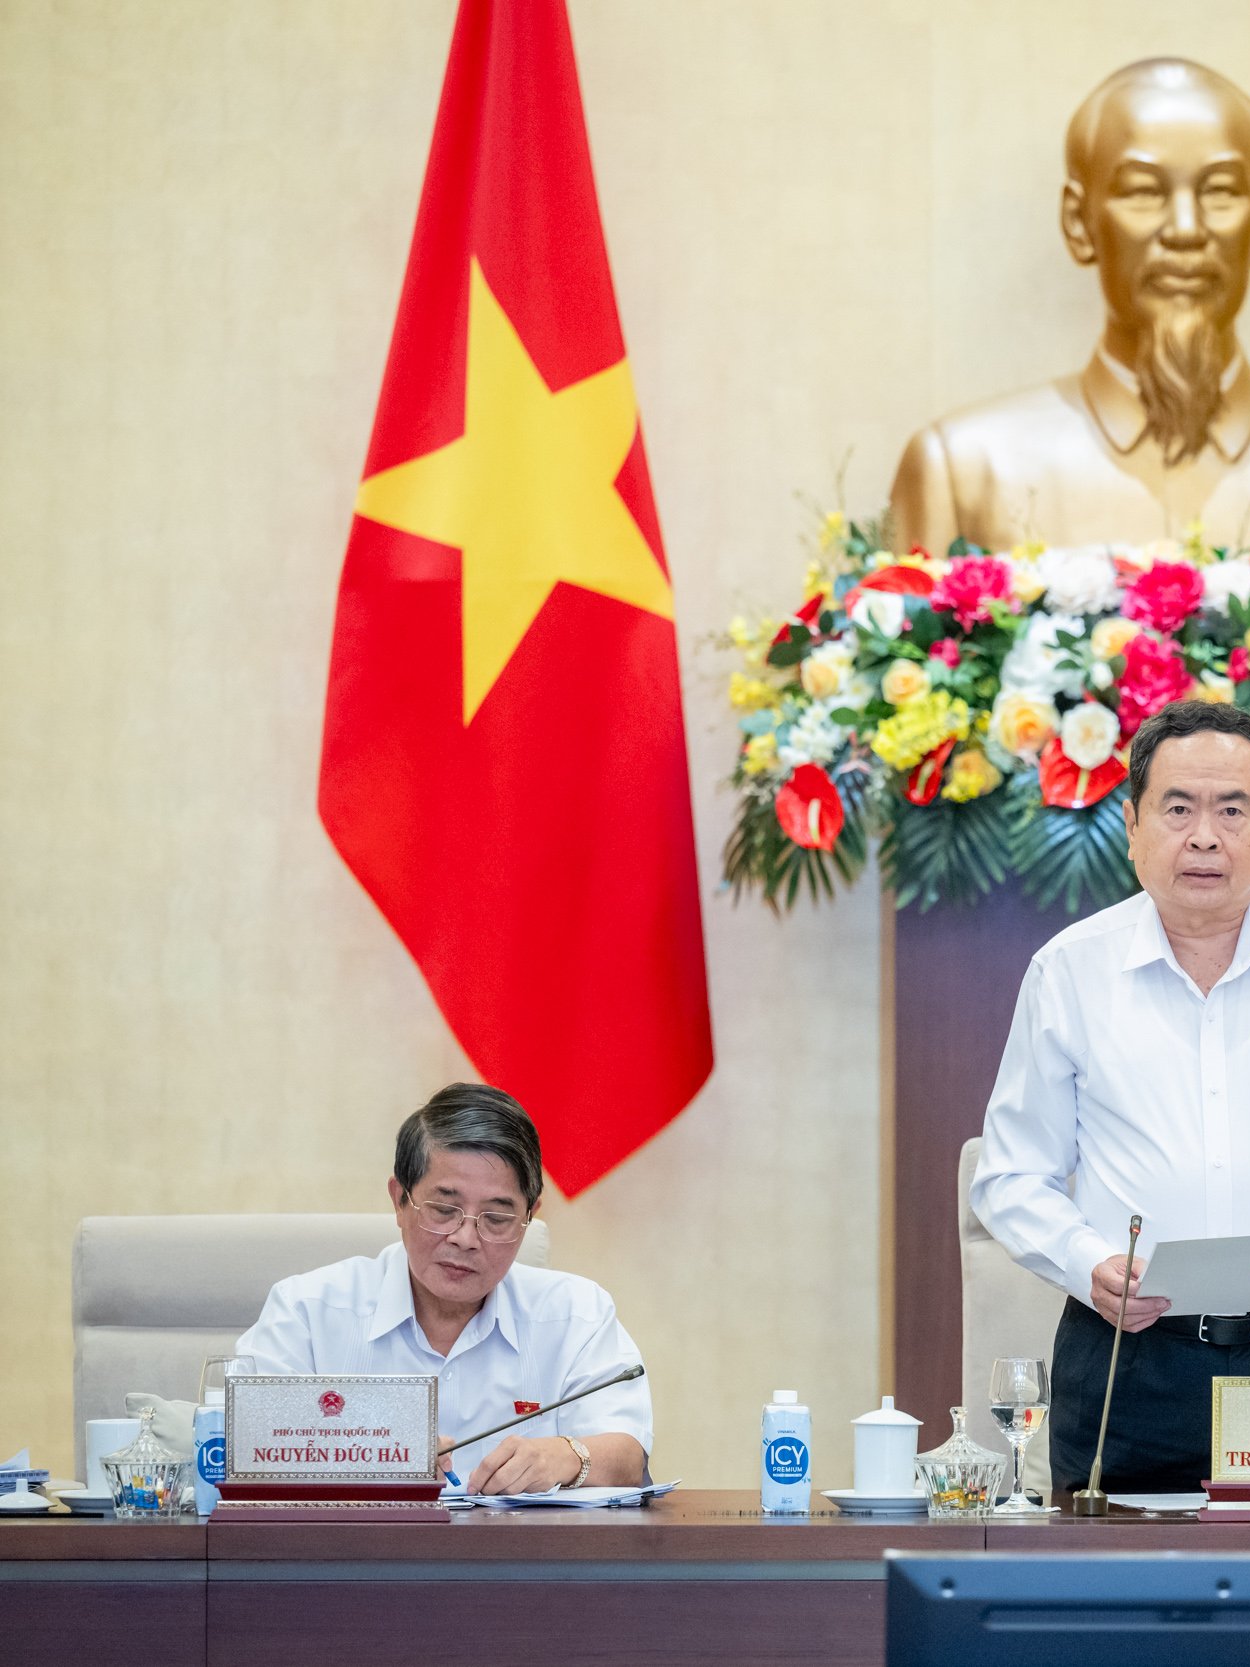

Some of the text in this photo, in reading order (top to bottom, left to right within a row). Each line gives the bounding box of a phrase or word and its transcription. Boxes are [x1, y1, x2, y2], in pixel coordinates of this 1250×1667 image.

[272, 1426, 390, 1438] PHÓ CHỦ TỊCH QUỐC HỘI
[203, 1446, 226, 1467] IC
[253, 1440, 410, 1463] NGUYỄN ĐỨC HẢI
[770, 1445, 805, 1466] ICY
